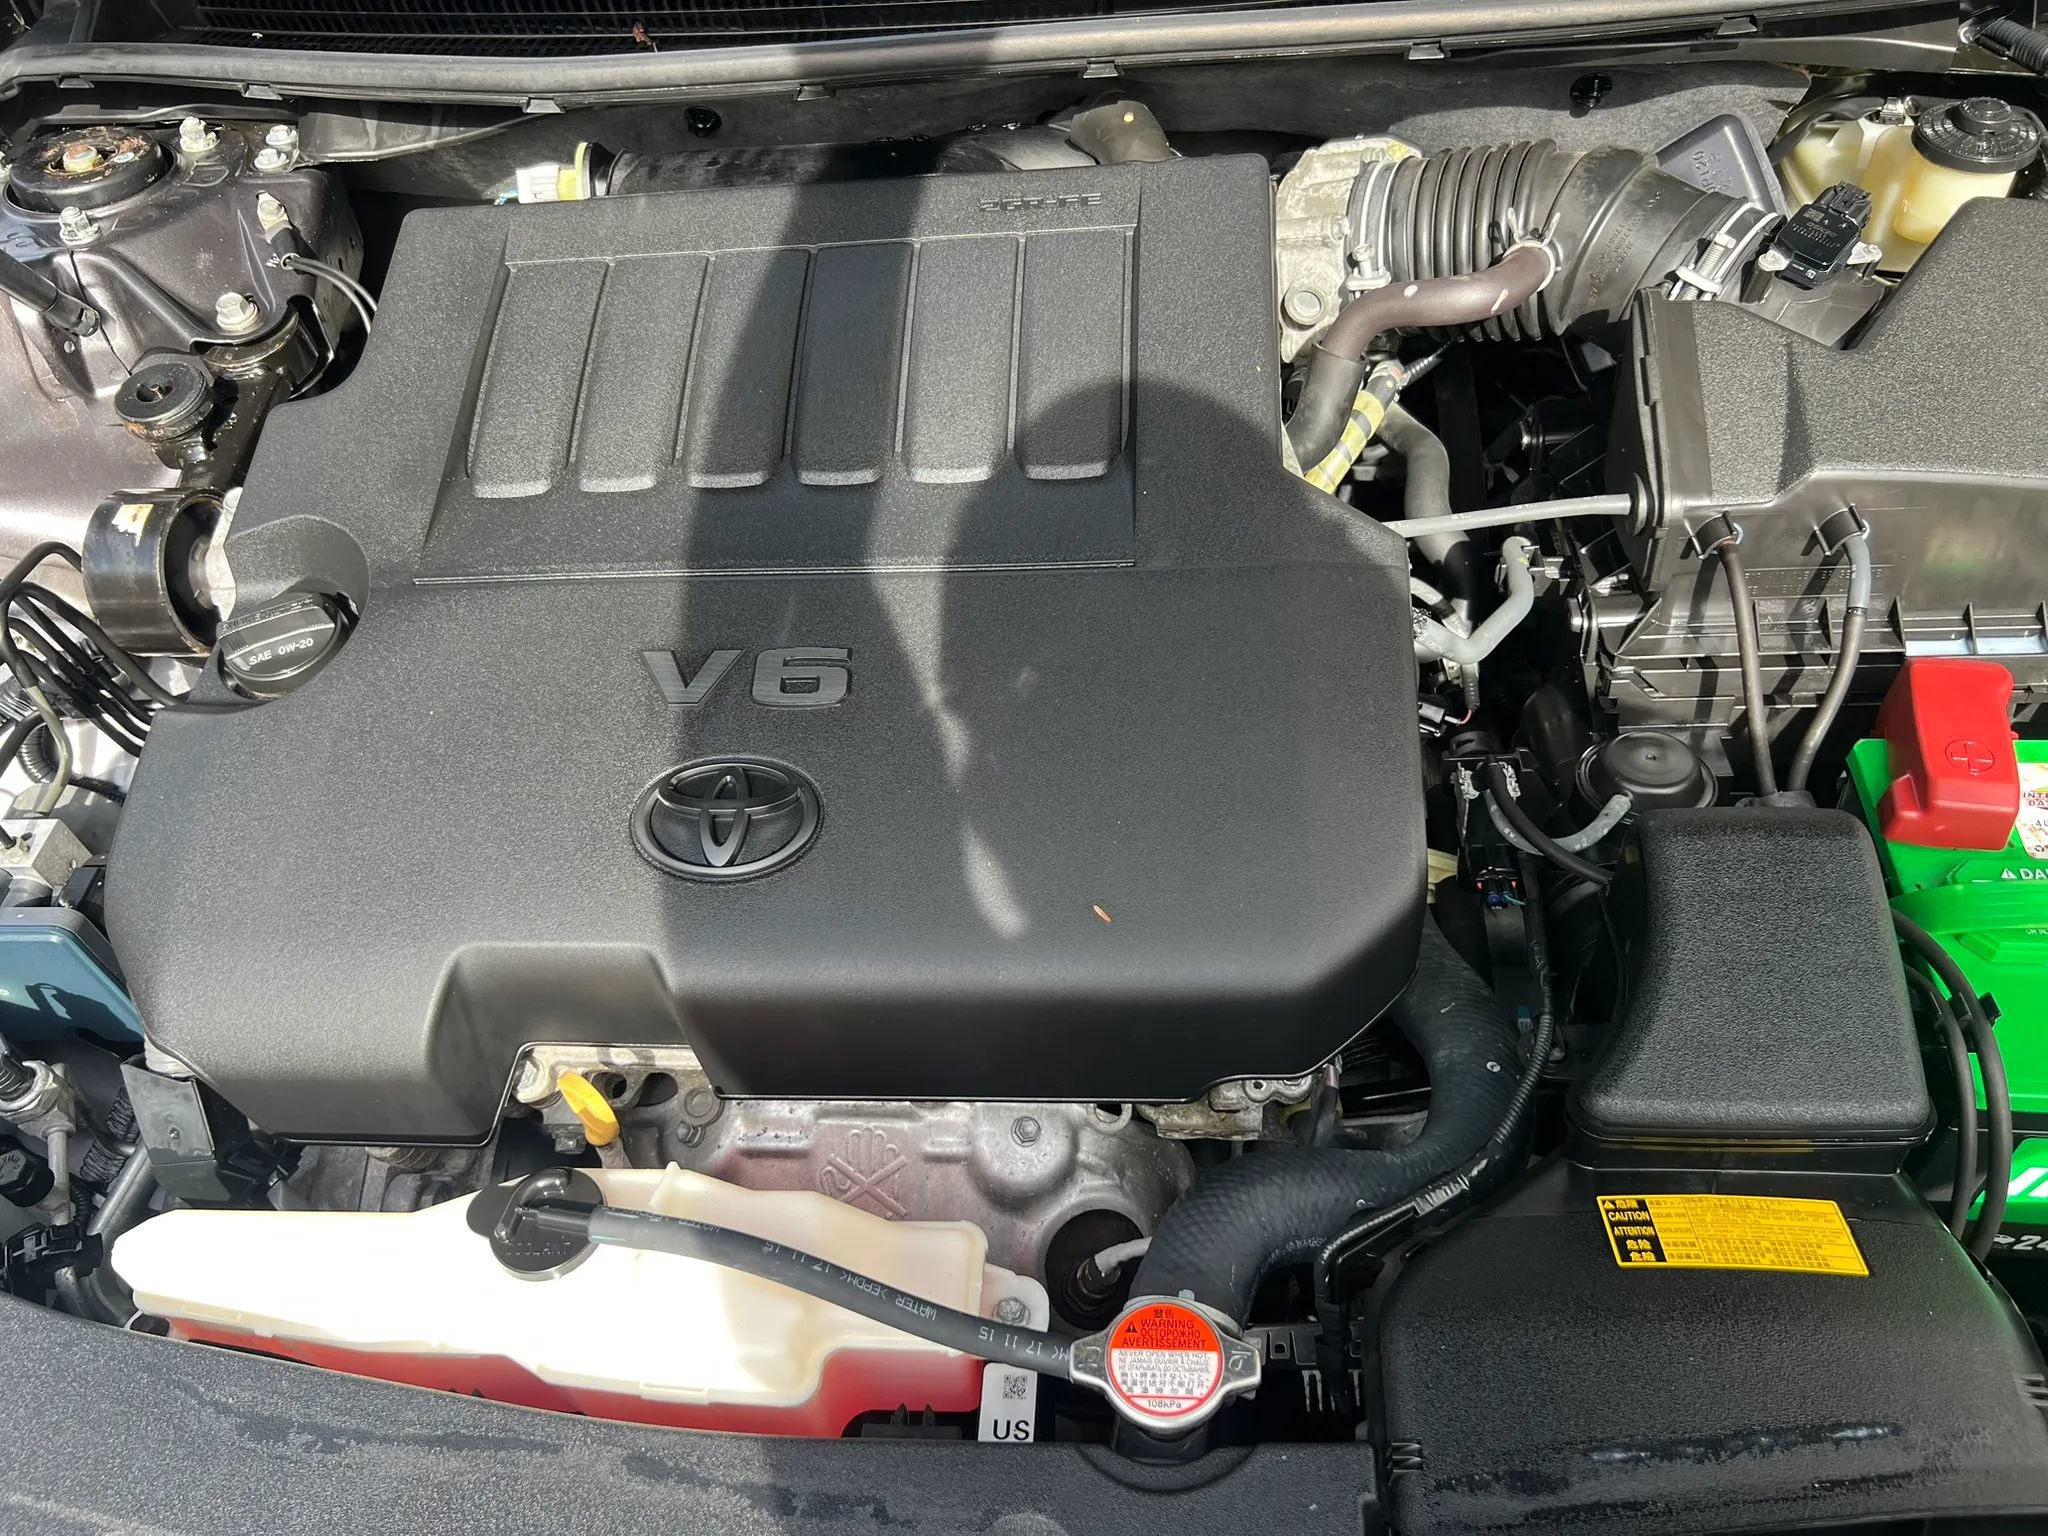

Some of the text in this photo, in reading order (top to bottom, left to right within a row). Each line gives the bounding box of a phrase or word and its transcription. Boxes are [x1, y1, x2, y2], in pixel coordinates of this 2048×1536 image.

[249, 638, 314, 665] SAE 0W-20
[642, 647, 852, 709] V6
[1608, 1211, 1650, 1221] CAUTION
[1613, 1226, 1655, 1236] ATTENTION
[895, 1293, 937, 1321] WATER
[1141, 1319, 1194, 1329] WARNING
[978, 1326, 995, 1341] 15
[1140, 1328, 1201, 1339] ОСТОРОЖНО
[1005, 1334, 1018, 1349] 11
[1026, 1340, 1042, 1356] 17
[1122, 1337, 1206, 1348] AVERTISSEMENT
[1148, 1400, 1182, 1408] 108kPa
[993, 1419, 1030, 1441] US
